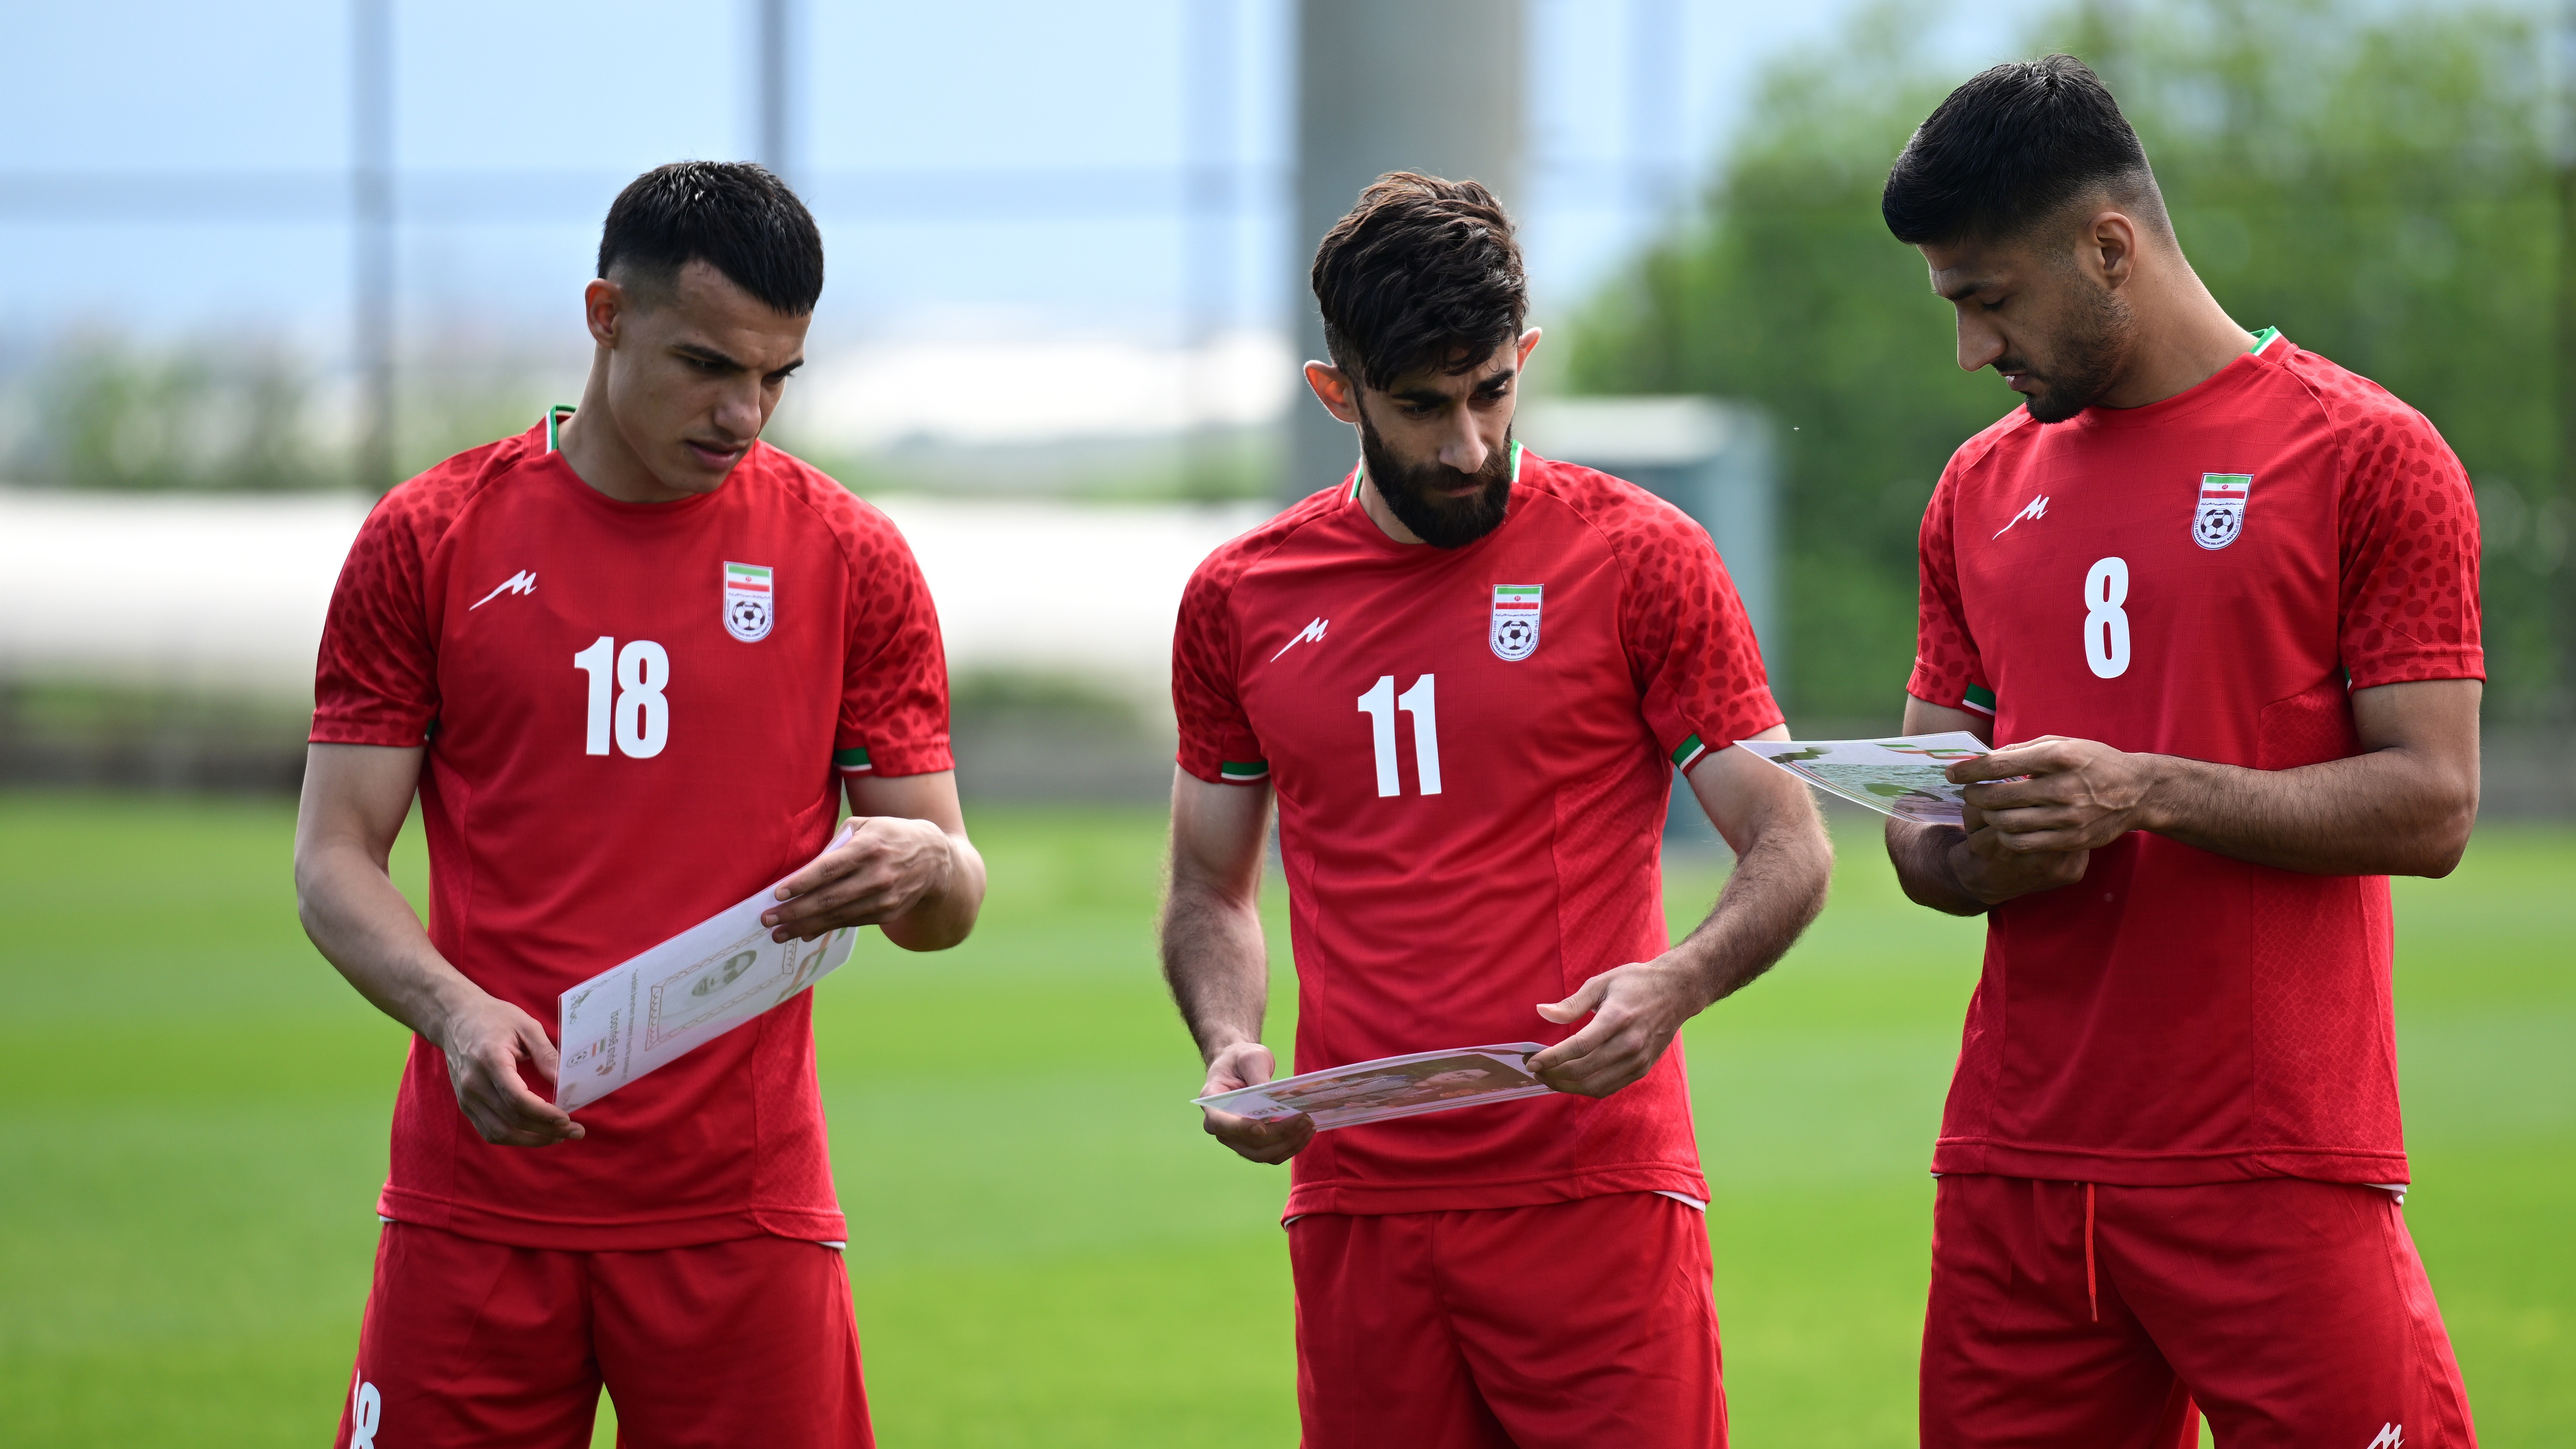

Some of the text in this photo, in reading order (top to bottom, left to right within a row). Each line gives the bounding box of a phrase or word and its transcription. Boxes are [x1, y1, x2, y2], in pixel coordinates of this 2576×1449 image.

[2227, 524, 2239, 541] REPUBLIC
[2084, 556, 2131, 679] 8
[574, 636, 670, 759] 18
[1357, 673, 1442, 798] 11
